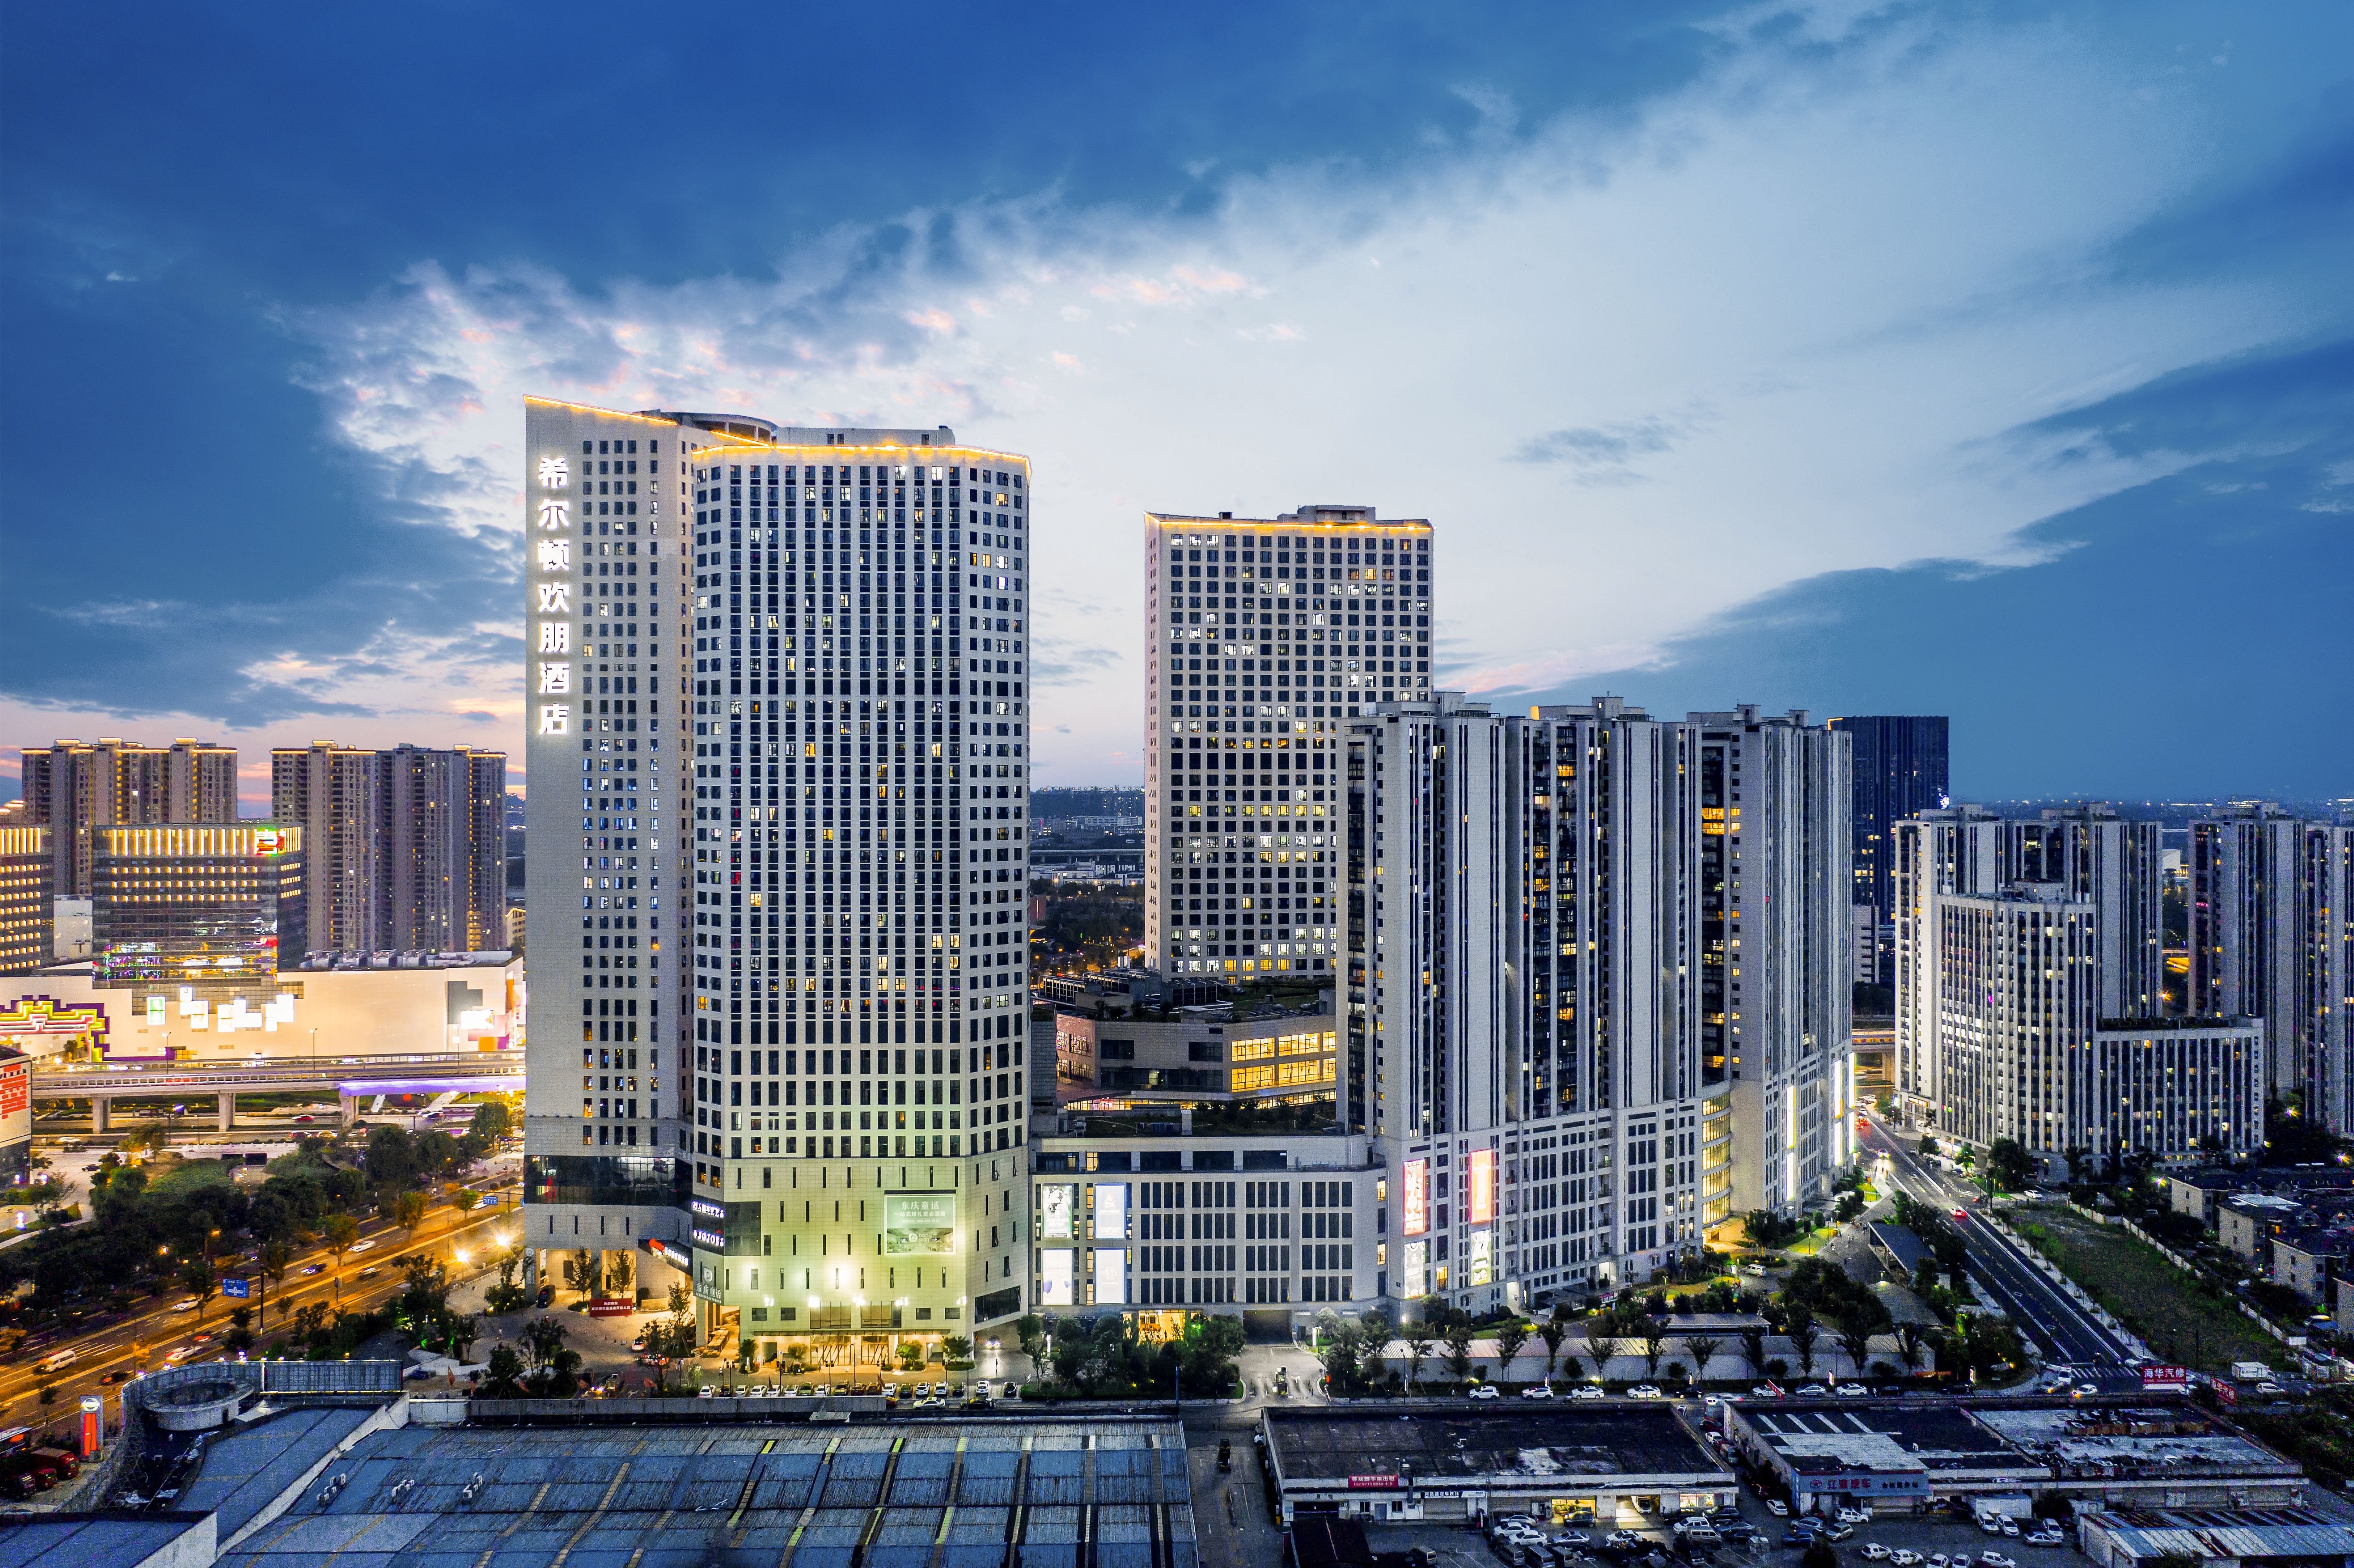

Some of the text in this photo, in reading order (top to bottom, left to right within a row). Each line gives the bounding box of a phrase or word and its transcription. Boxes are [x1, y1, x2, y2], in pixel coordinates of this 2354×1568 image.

[538, 456, 570, 735] 希尔顿欢朋酒店
[902, 1201, 939, 1210] 东庆童话
[2144, 1368, 2185, 1378] 海华汽修
